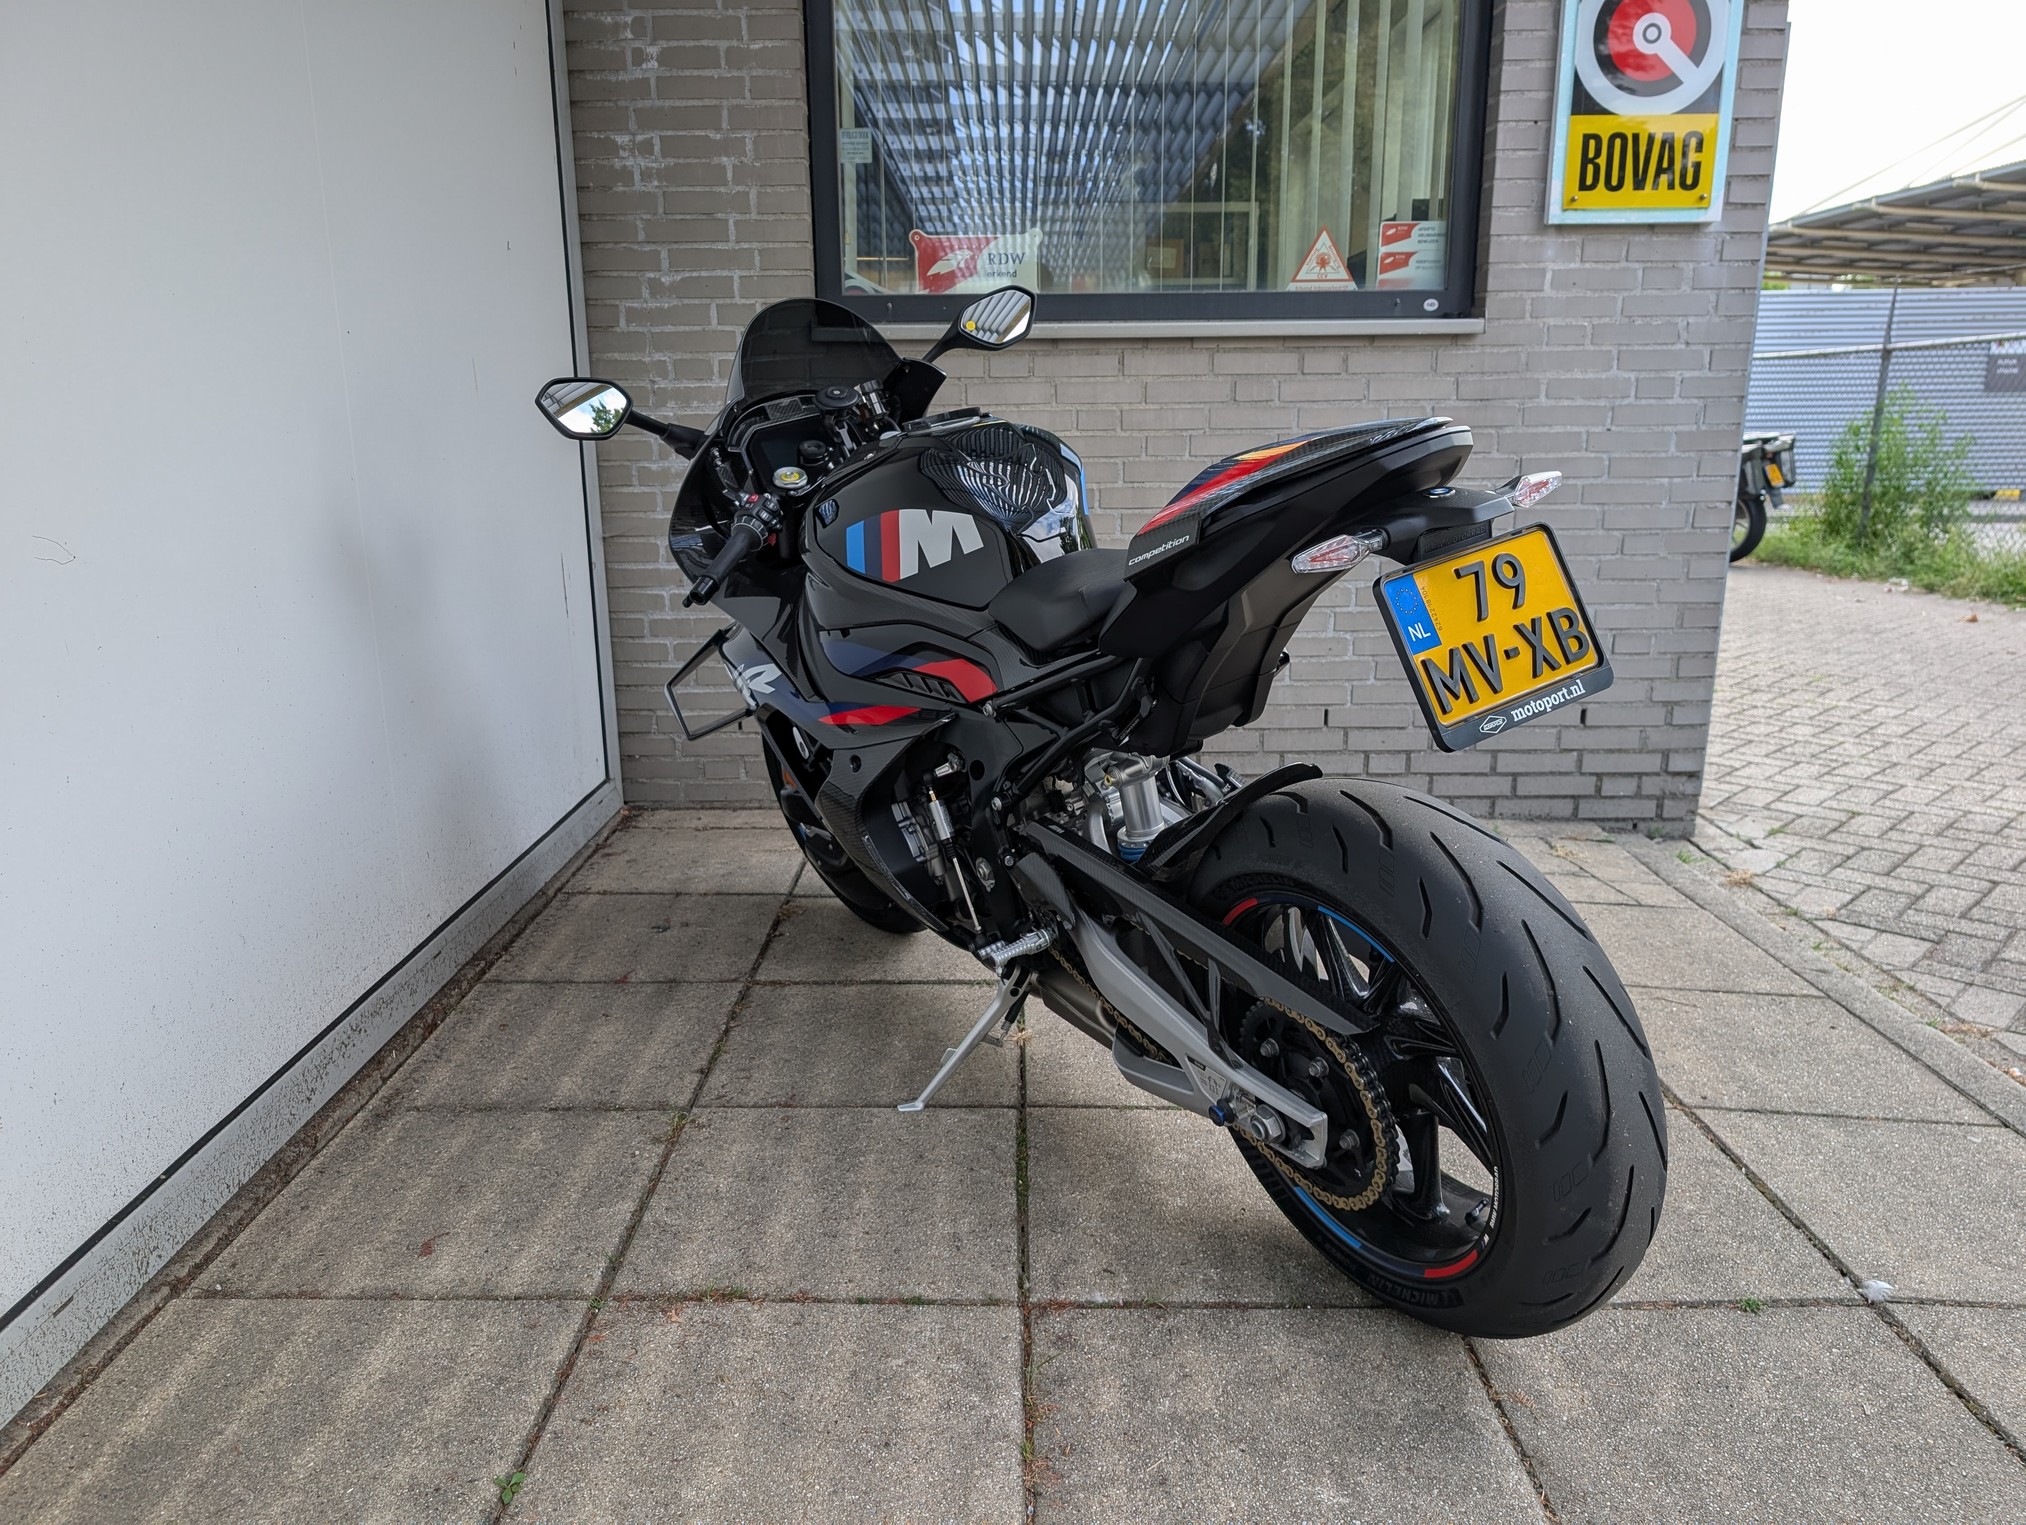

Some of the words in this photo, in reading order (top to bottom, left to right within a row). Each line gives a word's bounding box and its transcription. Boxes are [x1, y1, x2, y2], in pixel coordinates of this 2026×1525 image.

[1578, 130, 1705, 192] BOVAG
[987, 252, 1026, 265] RDW
[987, 269, 1017, 278] erkend
[899, 508, 985, 580] M
[1128, 535, 1190, 566] competition
[1452, 552, 1527, 623] 79
[1407, 621, 1431, 642] NL
[1419, 606, 1591, 716] MV-XB
[1511, 680, 1586, 722] motoport.nl
[1366, 1273, 1440, 1306] MICHELIN
